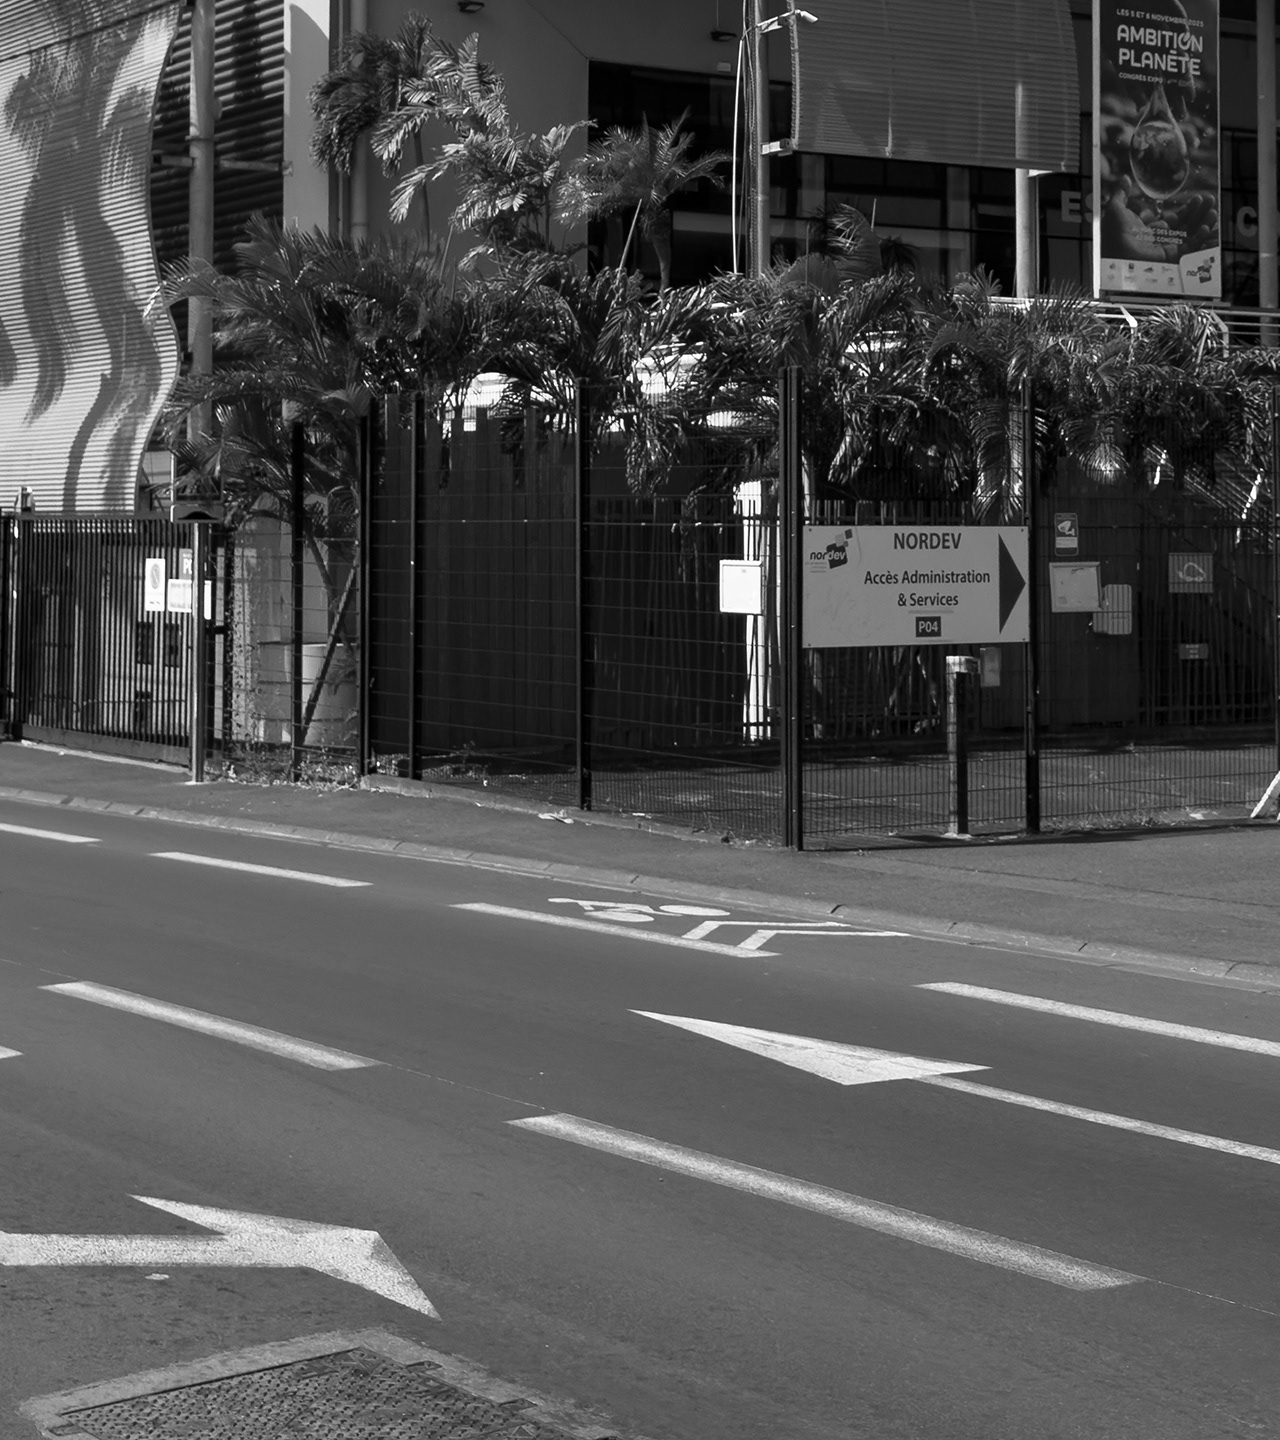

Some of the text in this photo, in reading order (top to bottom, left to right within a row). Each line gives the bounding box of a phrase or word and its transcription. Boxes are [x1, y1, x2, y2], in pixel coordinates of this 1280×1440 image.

[1117, 24, 1203, 53] AMBITION
[1119, 48, 1201, 76] PLANÈTE
[893, 532, 962, 549] NORDEV
[810, 549, 846, 561] nordev
[864, 570, 990, 584] Accès Administration
[897, 593, 958, 606] & Services
[918, 620, 939, 634] P04
